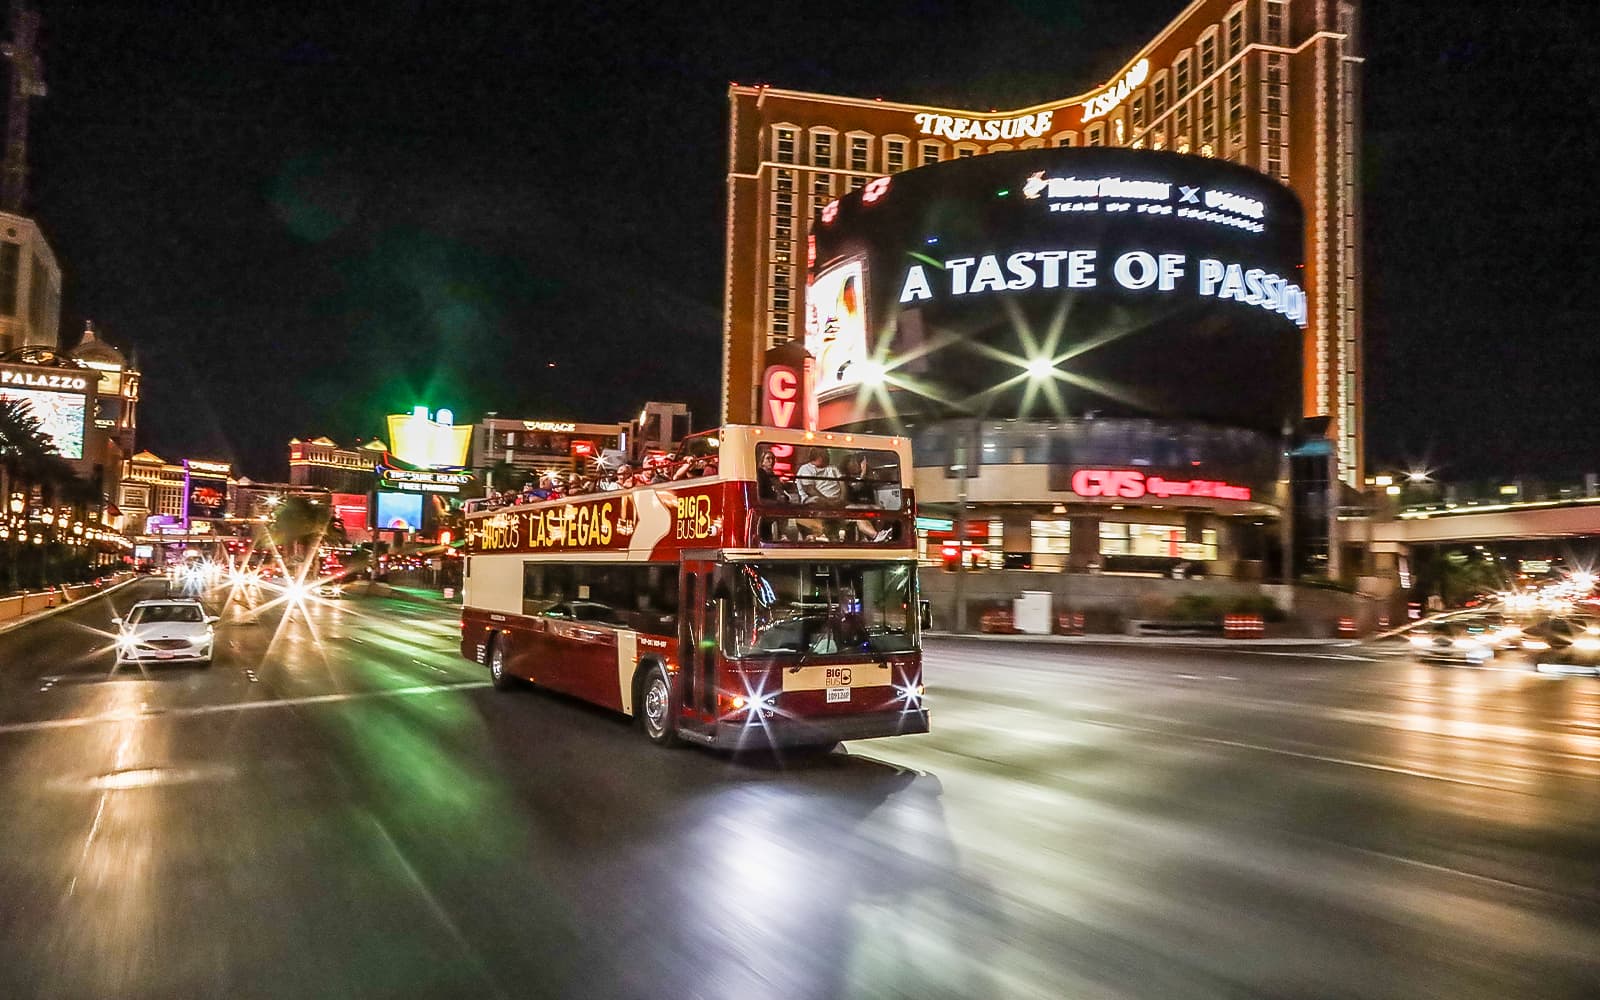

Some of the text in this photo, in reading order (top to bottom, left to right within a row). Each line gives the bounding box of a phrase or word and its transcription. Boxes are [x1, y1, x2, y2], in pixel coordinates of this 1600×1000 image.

[915, 58, 1149, 141] TREASURE ISLAND
[900, 265, 932, 302] A
[945, 250, 1096, 295] TASTE
[1114, 251, 1186, 291] OF
[0, 371, 87, 390] PALAZZO
[1072, 470, 1145, 498] CVS
[677, 496, 696, 519] BIG
[529, 510, 555, 548] LAS
[558, 502, 613, 546] VEGAS
[676, 519, 696, 540] BUS
[826, 668, 840, 678] BIG
